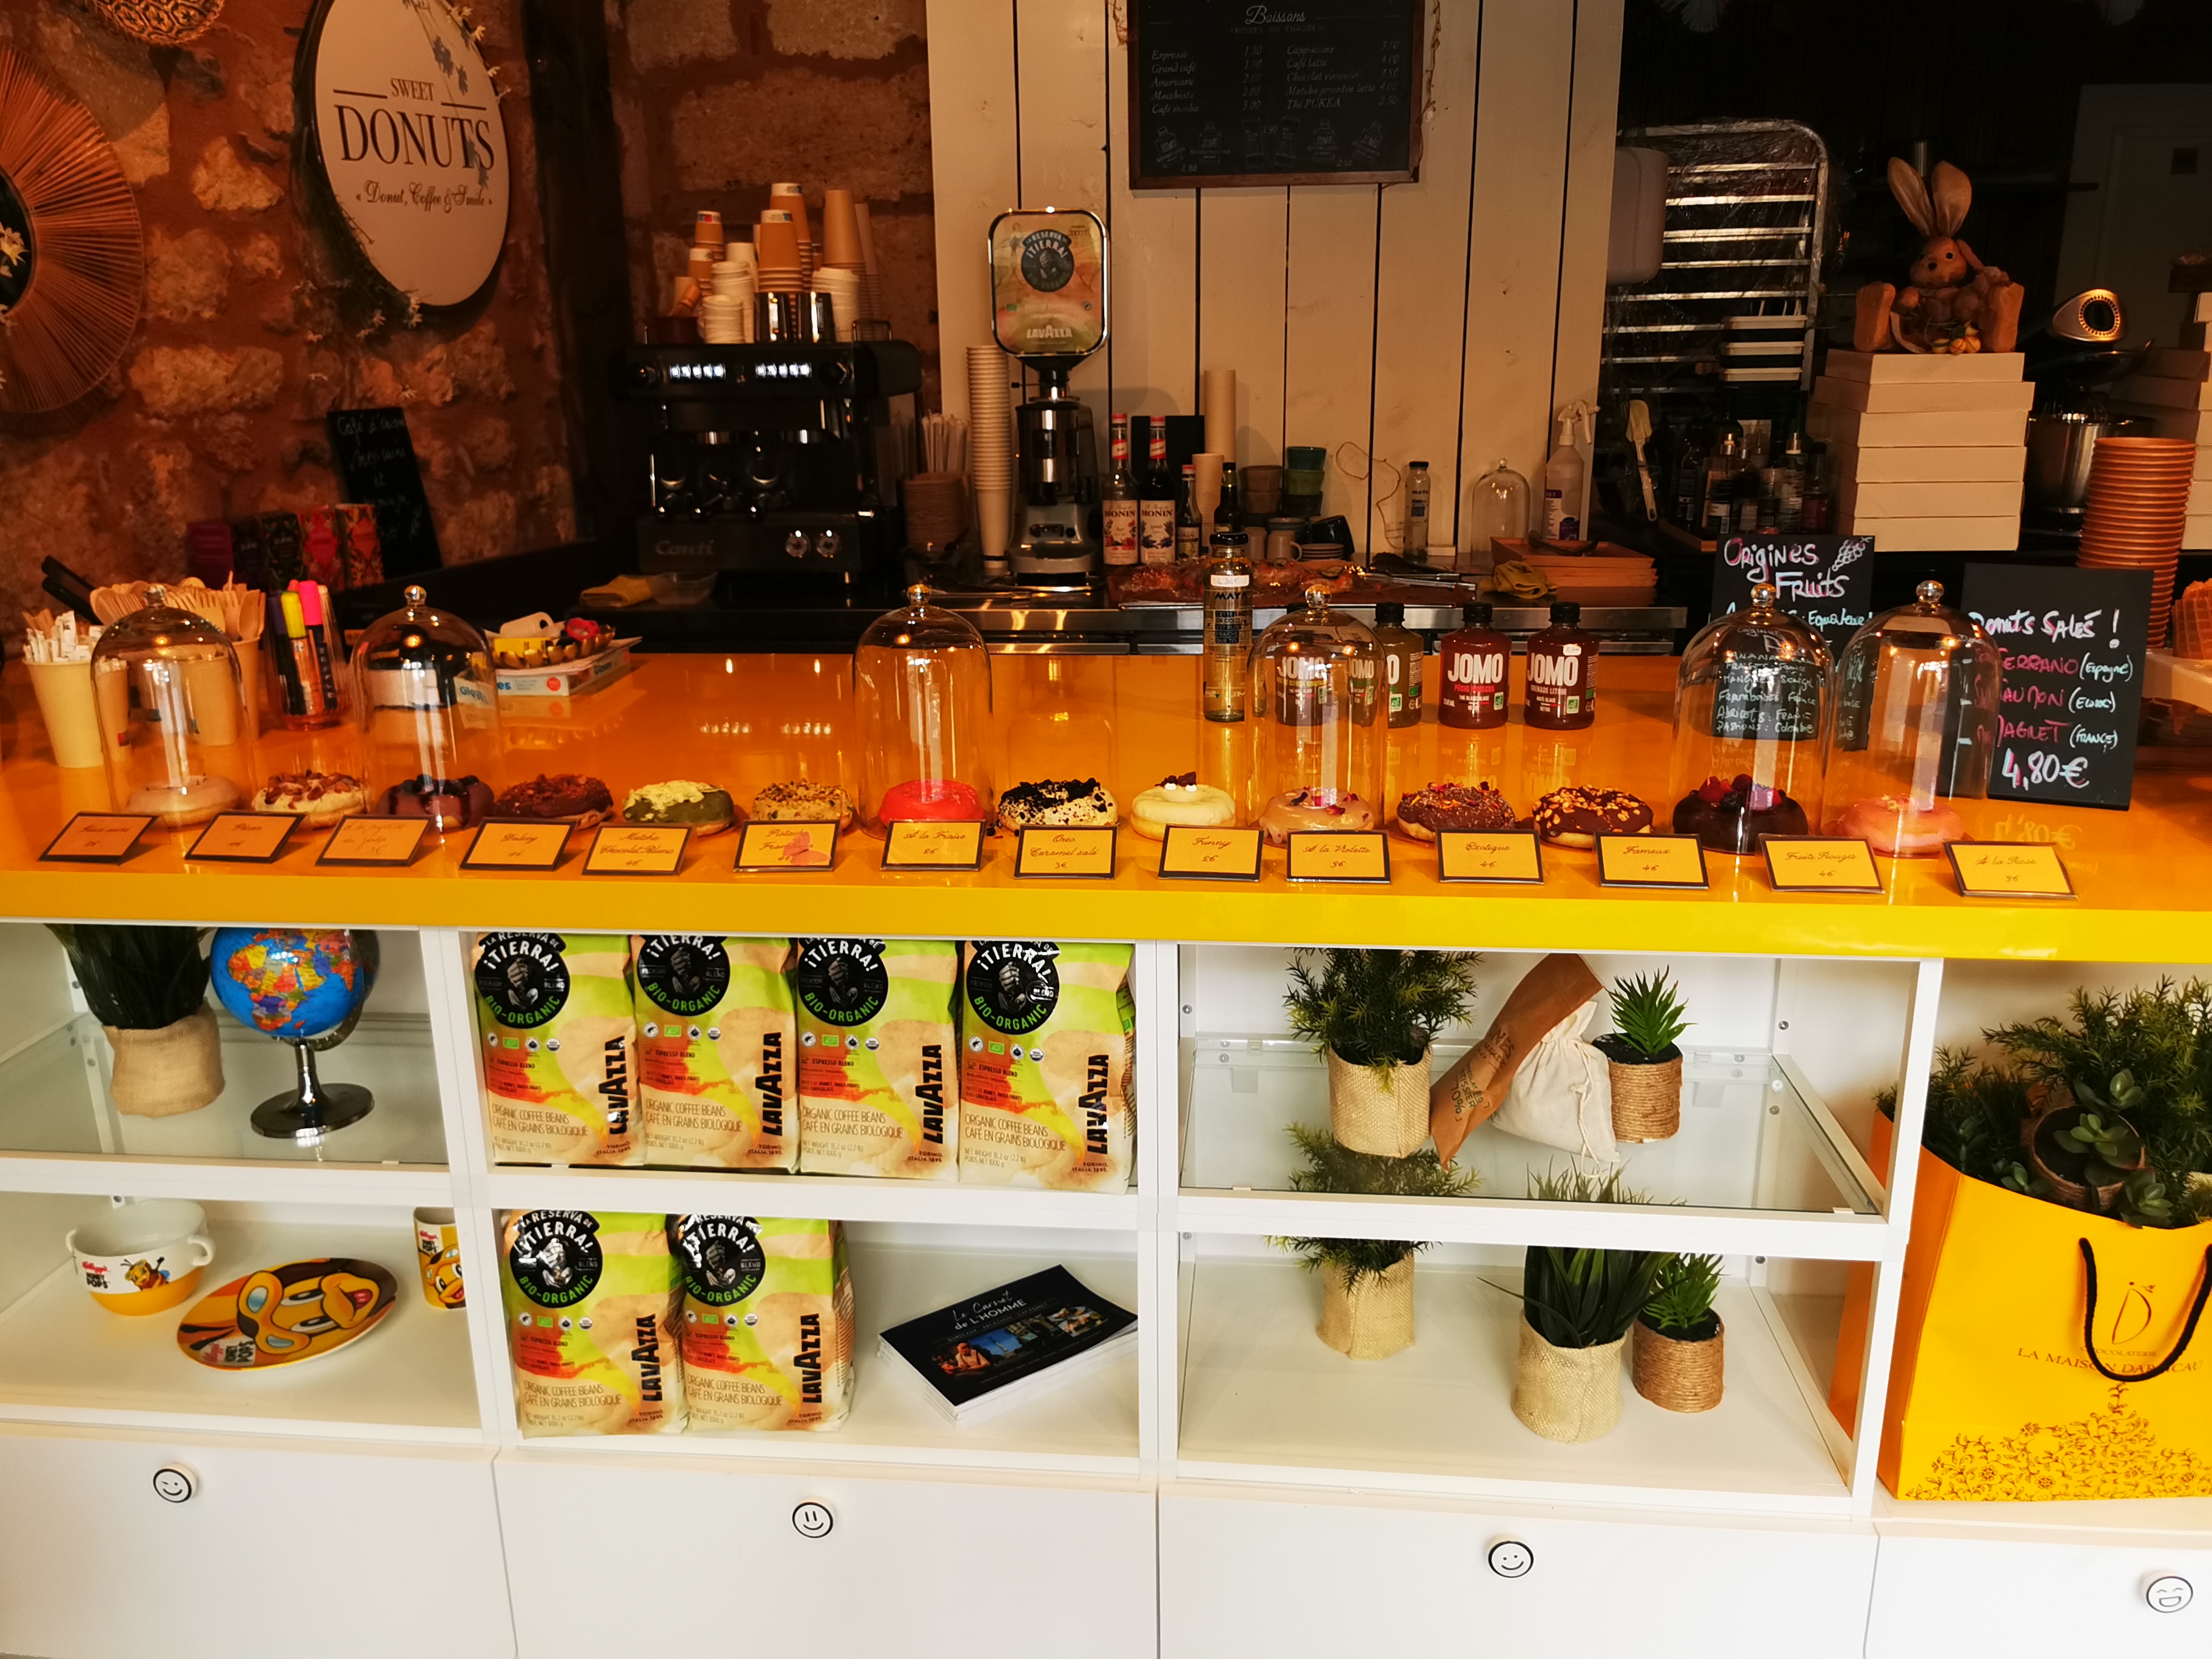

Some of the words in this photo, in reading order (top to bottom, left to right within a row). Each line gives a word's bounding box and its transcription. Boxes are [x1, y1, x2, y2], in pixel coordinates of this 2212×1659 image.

[1245, 4, 1306, 25] Boissons
[390, 77, 434, 101] SWEET
[333, 104, 495, 171] DONUTS
[1105, 509, 1136, 518] MONIN
[1141, 509, 1173, 518] MONIN
[1775, 567, 1850, 602] Fruits
[1447, 652, 1504, 684] JOMO
[1527, 652, 1579, 686] JOMO
[1030, 846, 1078, 857] Caramel
[1052, 834, 1076, 843] Oreo
[484, 940, 560, 971] ¡TIERRA!
[646, 936, 722, 960] ¡TIERRA!
[804, 940, 879, 971] ¡TIERRA!
[485, 995, 560, 1025] BIO-ORGANIC
[648, 982, 722, 1012] BIO-ORGANIC
[804, 992, 879, 1022] BIO-ORGANIC
[974, 996, 1047, 1030] BIO-ORGANIC
[598, 1035, 629, 1135] LAVAZZA
[756, 1032, 783, 1136] LAVAZZA
[915, 1045, 943, 1144] LAVAZZA
[675, 1102, 700, 1116] COFFEE
[702, 1104, 726, 1117] BEANS
[802, 1107, 833, 1121] ORGANIC
[834, 1109, 860, 1122] COFFEE
[861, 1110, 886, 1124] BEANS
[1078, 1054, 1109, 1155] LAVAZZA
[662, 1116, 671, 1126] EN
[673, 1116, 700, 1129] GRAINS
[701, 1118, 743, 1132] BIOLOGIQUE
[820, 1122, 830, 1133] EN
[831, 1123, 859, 1135] GRAINS
[861, 1124, 903, 1138] BIOLOGIQUE
[965, 1113, 996, 1127] ORGANIC
[997, 1119, 1024, 1134] COFFEE
[1025, 1124, 1048, 1136] BEANS
[965, 1126, 982, 1140] CAFÉ
[984, 1130, 994, 1142] EN
[995, 1133, 1022, 1147] GRAINS
[1023, 1136, 1066, 1151] BIOLOGIQUE
[519, 1275, 594, 1304] BIO-ORGANIC
[685, 1274, 757, 1302] BIO-ORGANIC
[952, 1309, 968, 1321] Le
[972, 1289, 1013, 1314] Carnet
[954, 1321, 969, 1330] de
[969, 1298, 1027, 1324] L'HOMME
[631, 1313, 663, 1402] LAVAZZA
[794, 1313, 822, 1404] LAVAZZA
[2017, 1347, 2040, 1361] LA
